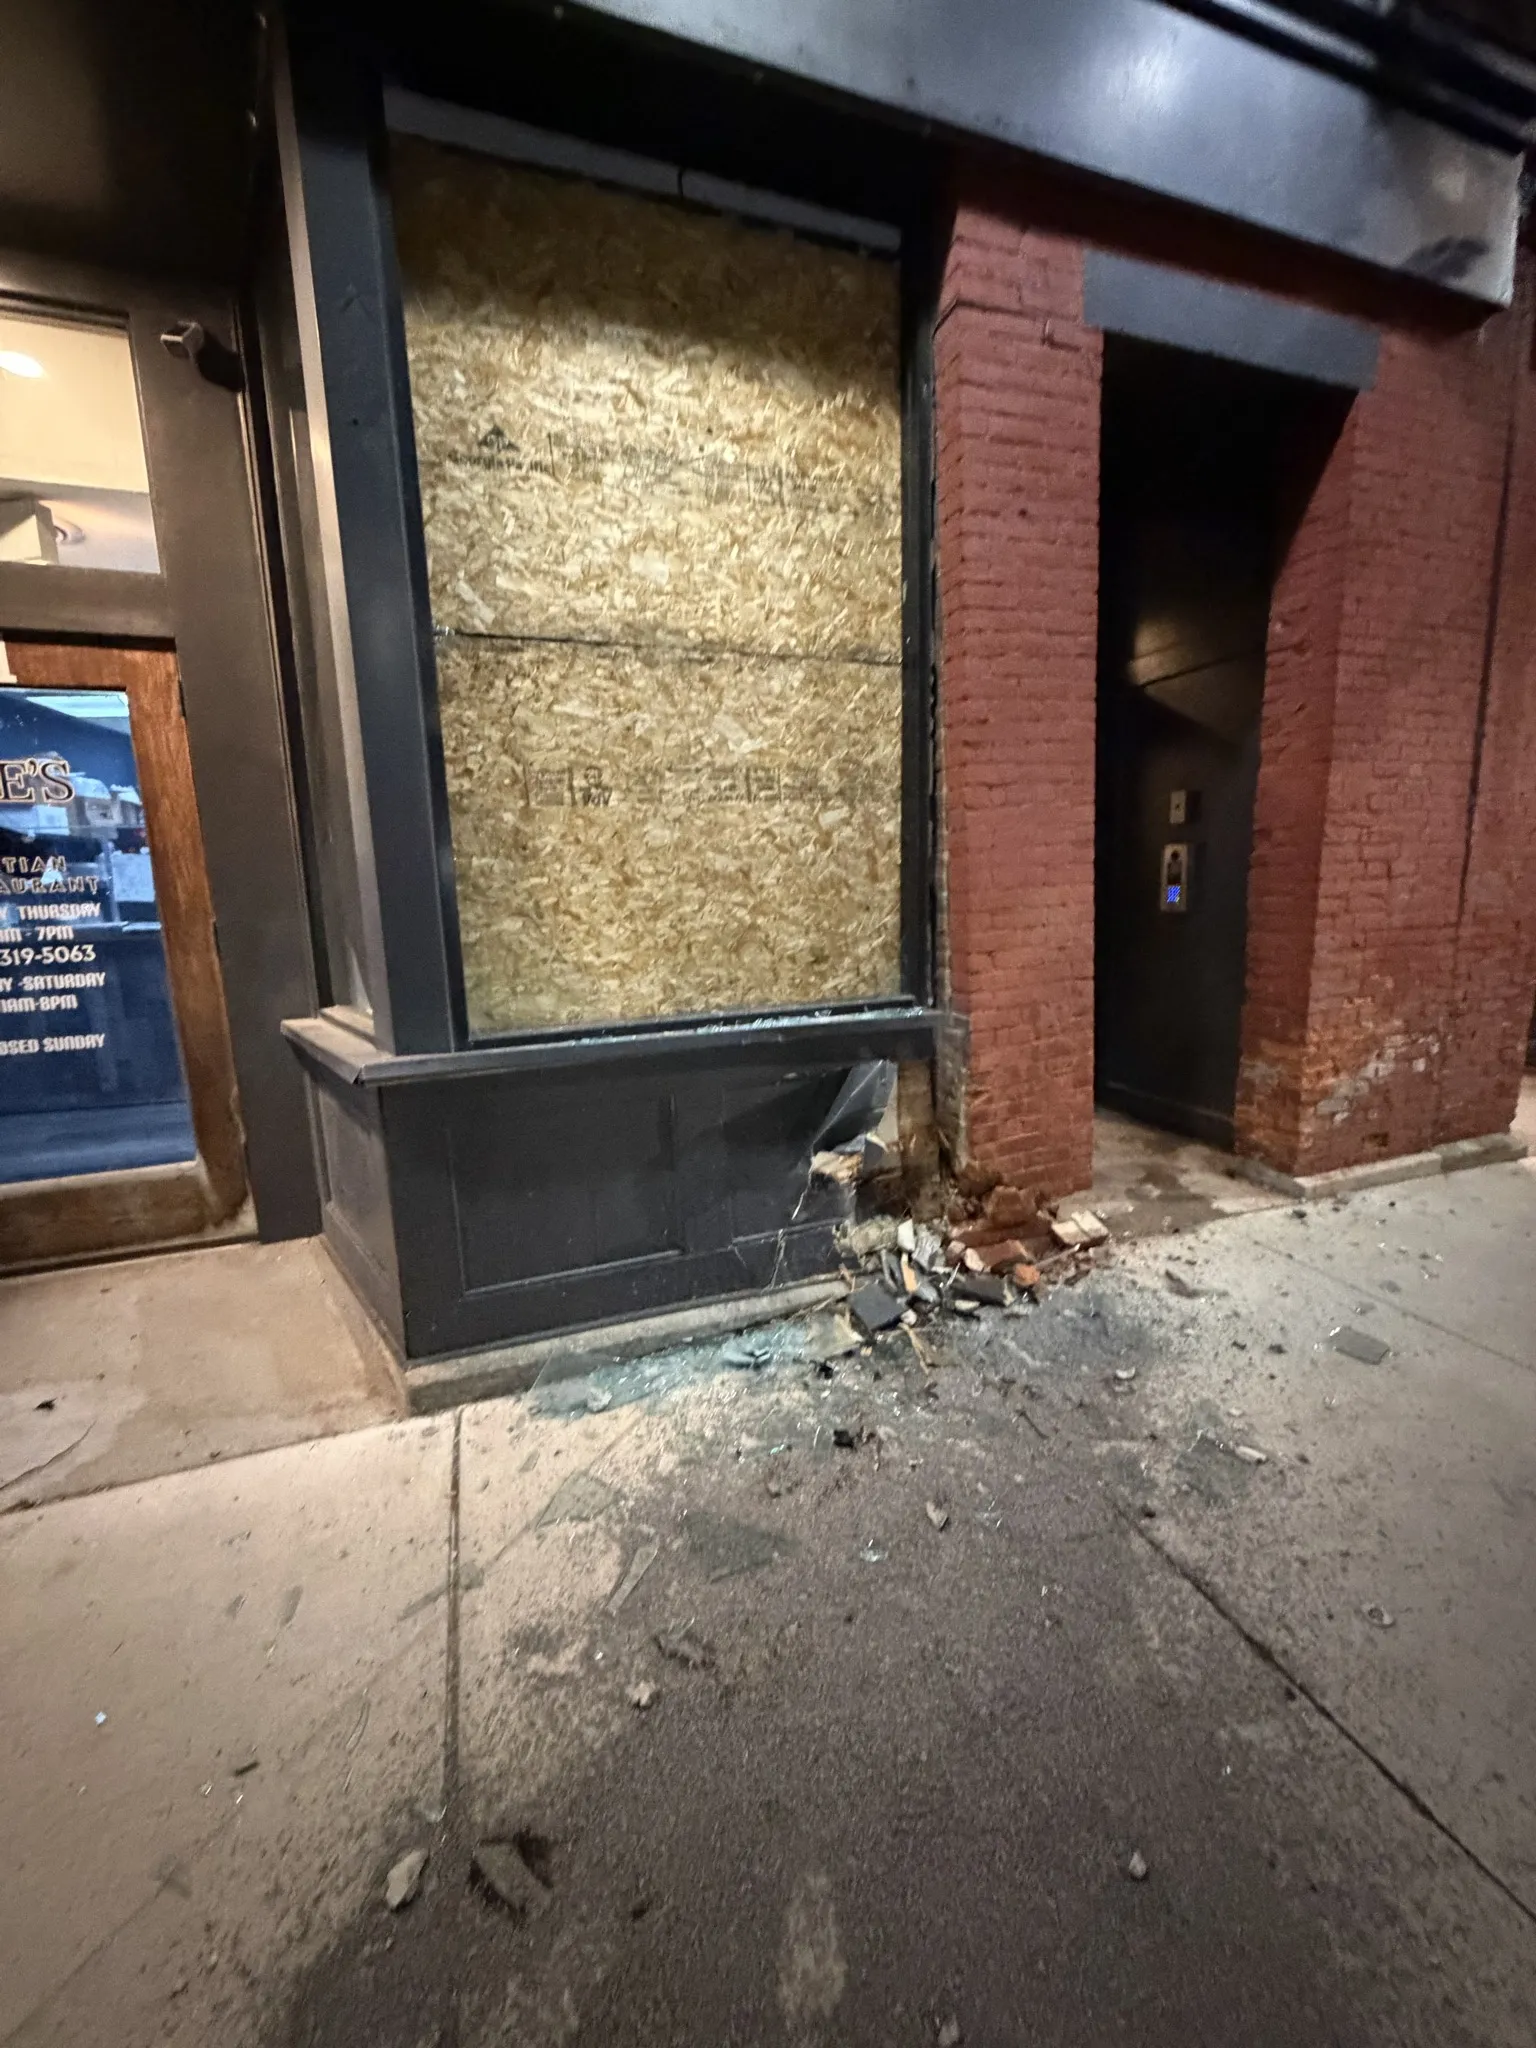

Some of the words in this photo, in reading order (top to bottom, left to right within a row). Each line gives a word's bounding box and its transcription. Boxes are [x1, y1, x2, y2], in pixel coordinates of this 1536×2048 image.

[18, 902, 101, 920] THURSDAY
[0, 944, 96, 967] 319-5063
[43, 1034, 105, 1053] SUNDAY
